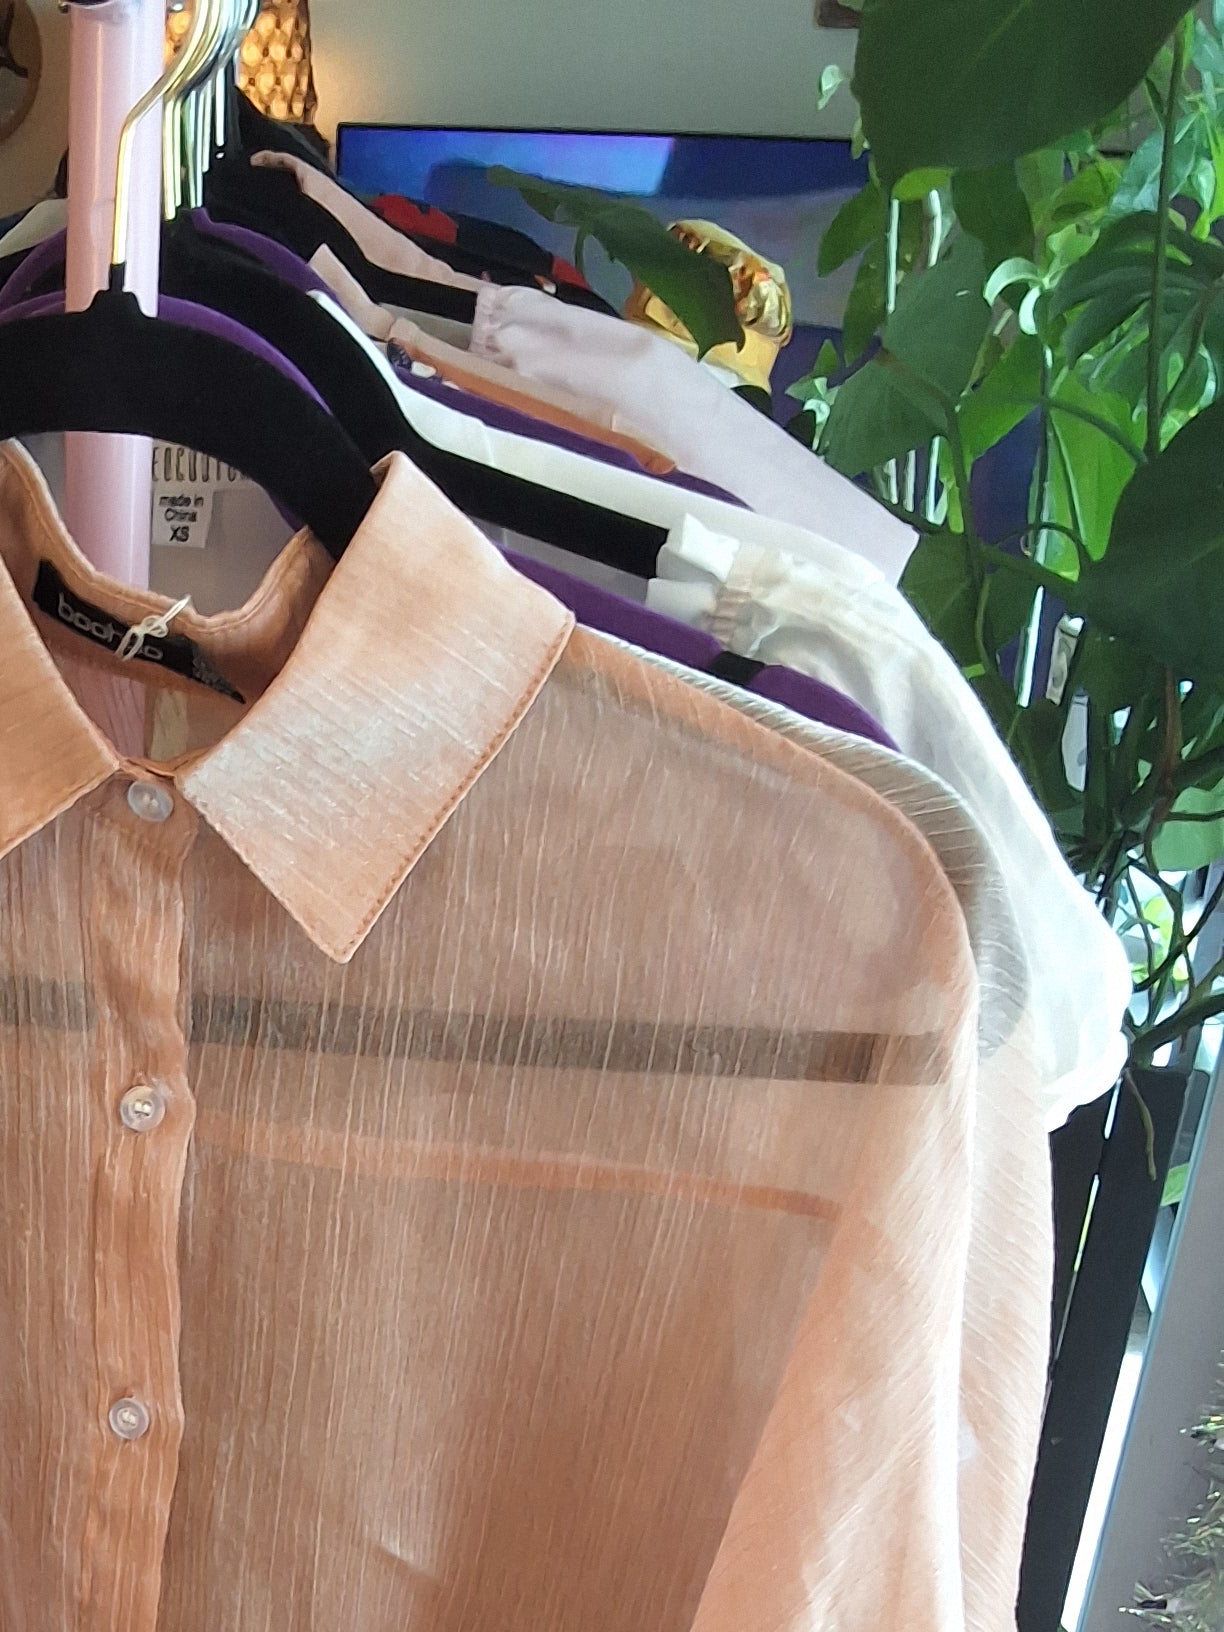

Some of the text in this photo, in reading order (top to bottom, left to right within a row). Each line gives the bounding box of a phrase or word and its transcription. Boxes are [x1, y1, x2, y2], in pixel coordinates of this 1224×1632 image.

[158, 494, 204, 507] made in
[164, 508, 197, 523] China
[169, 525, 190, 542] XS
